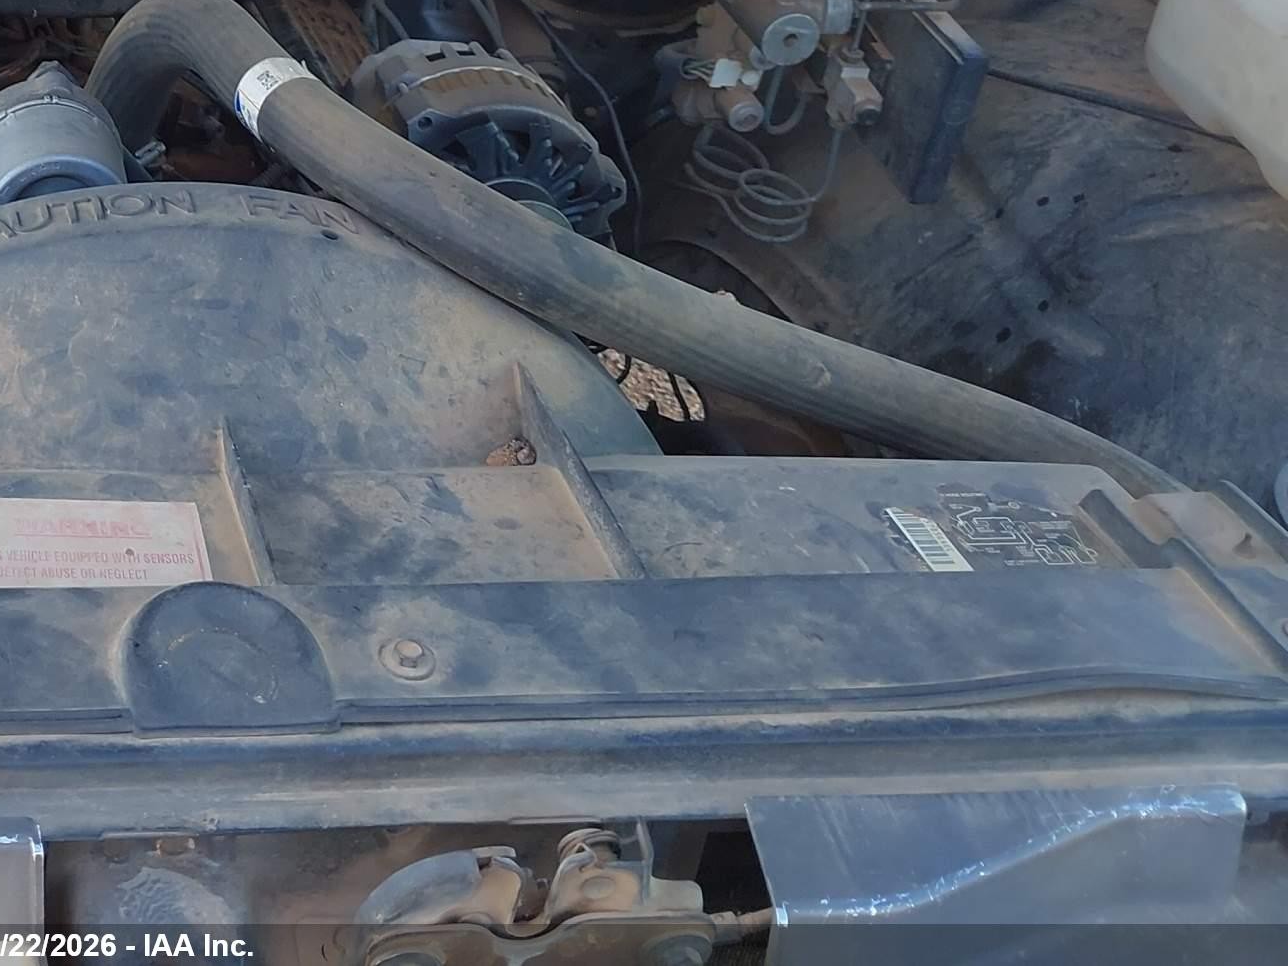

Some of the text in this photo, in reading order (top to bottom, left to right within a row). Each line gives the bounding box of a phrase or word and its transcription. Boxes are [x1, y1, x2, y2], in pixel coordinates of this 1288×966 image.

[239, 194, 360, 235] FAN
[6, 550, 50, 563] VEHICLE
[54, 550, 109, 564] EQUIPPED
[111, 551, 140, 565] WITH
[143, 552, 194, 565] SENSORS
[41, 567, 77, 579] ABUSE
[80, 567, 96, 579] OR
[99, 567, 148, 580] NEGLECT
